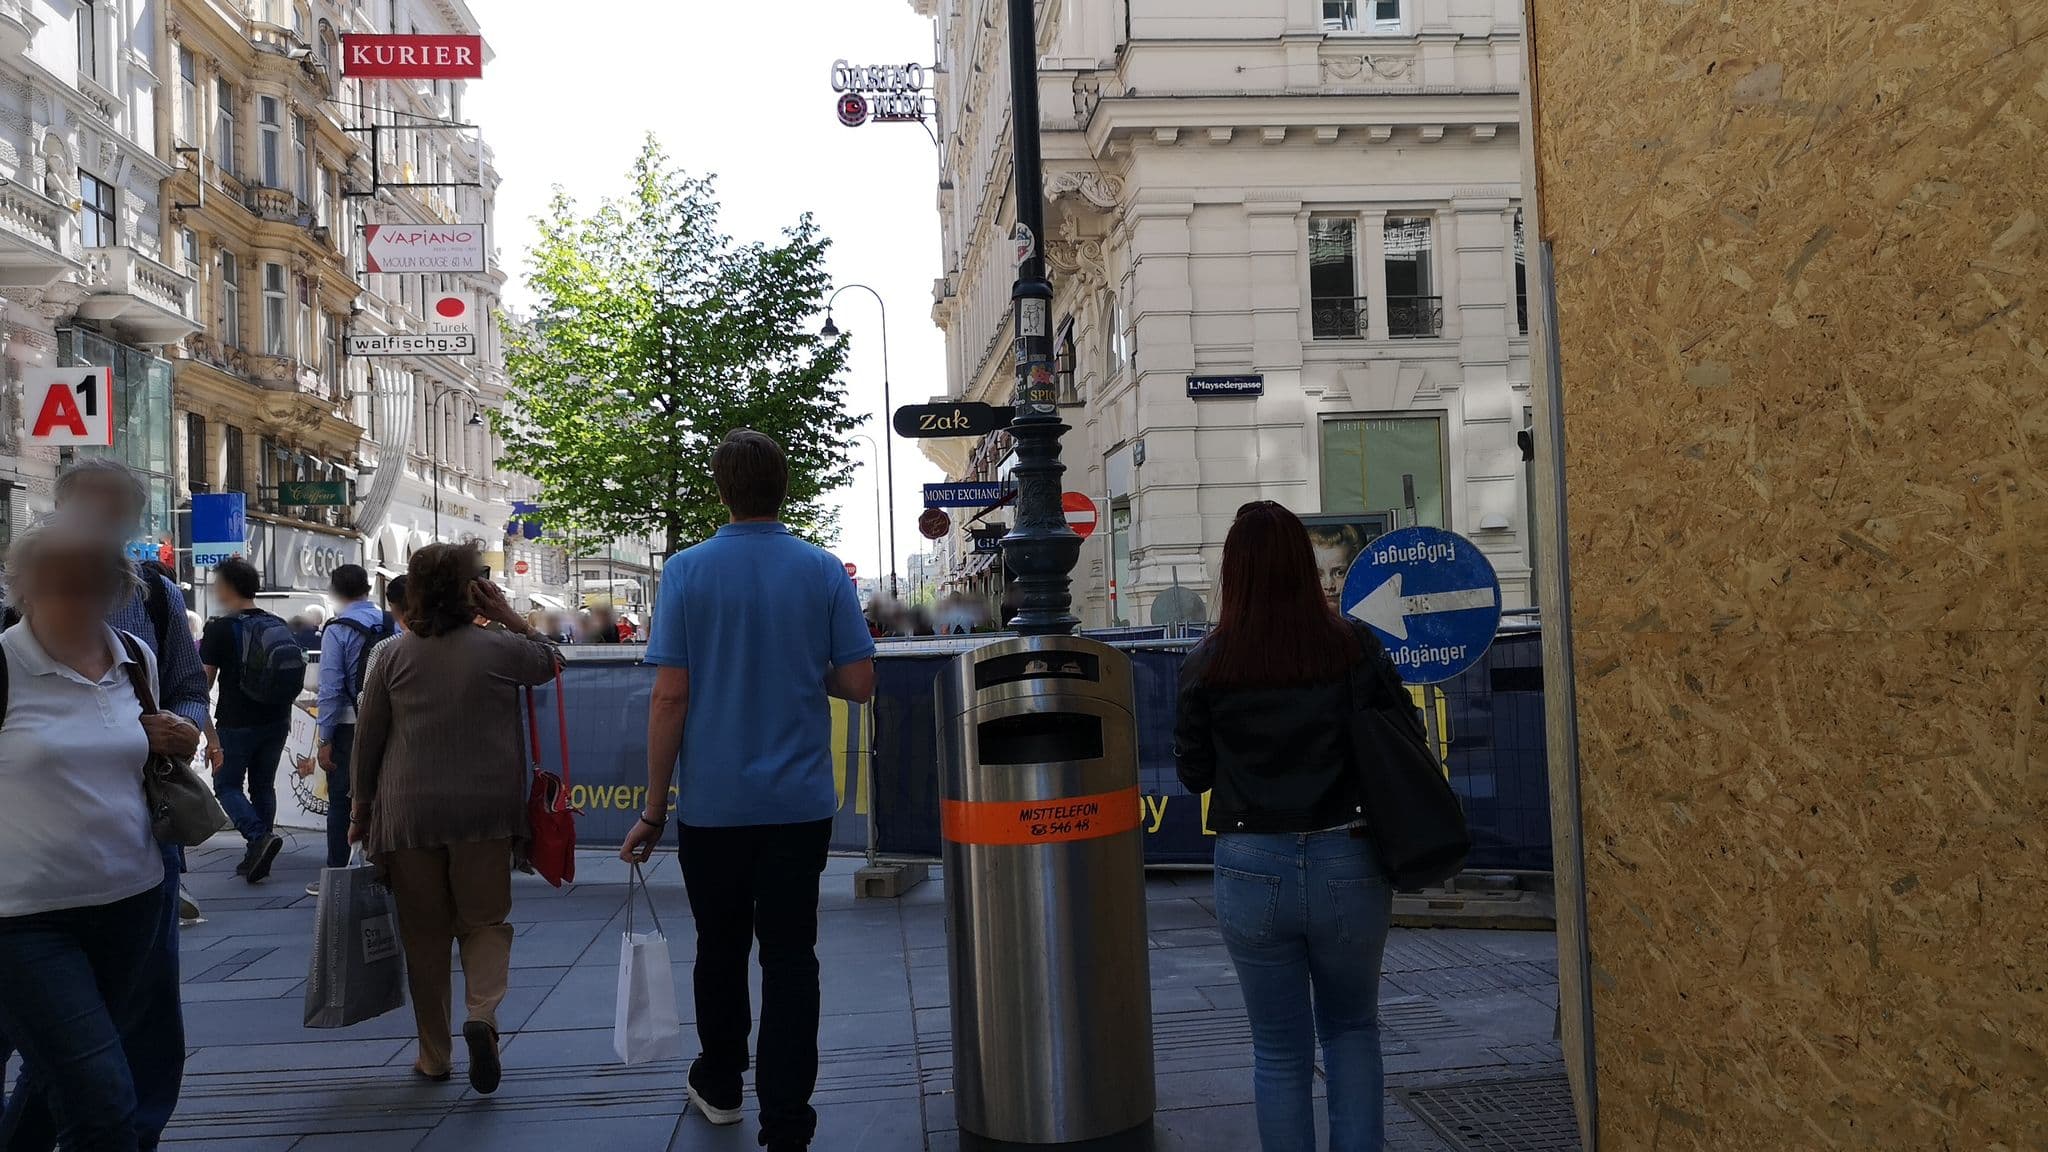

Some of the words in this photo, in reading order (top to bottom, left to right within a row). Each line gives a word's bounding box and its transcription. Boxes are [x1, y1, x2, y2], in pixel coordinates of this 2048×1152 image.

[352, 45, 474, 65] KURIER
[831, 59, 924, 92] CASINO
[433, 322, 468, 332] Turek
[355, 337, 467, 351] walfischg.3
[32, 375, 97, 436] A1
[920, 409, 971, 430] Zak
[925, 489, 956, 501] MONEY
[958, 488, 1001, 500] EXCHANG
[1020, 803, 1098, 821] MISTTELEFON
